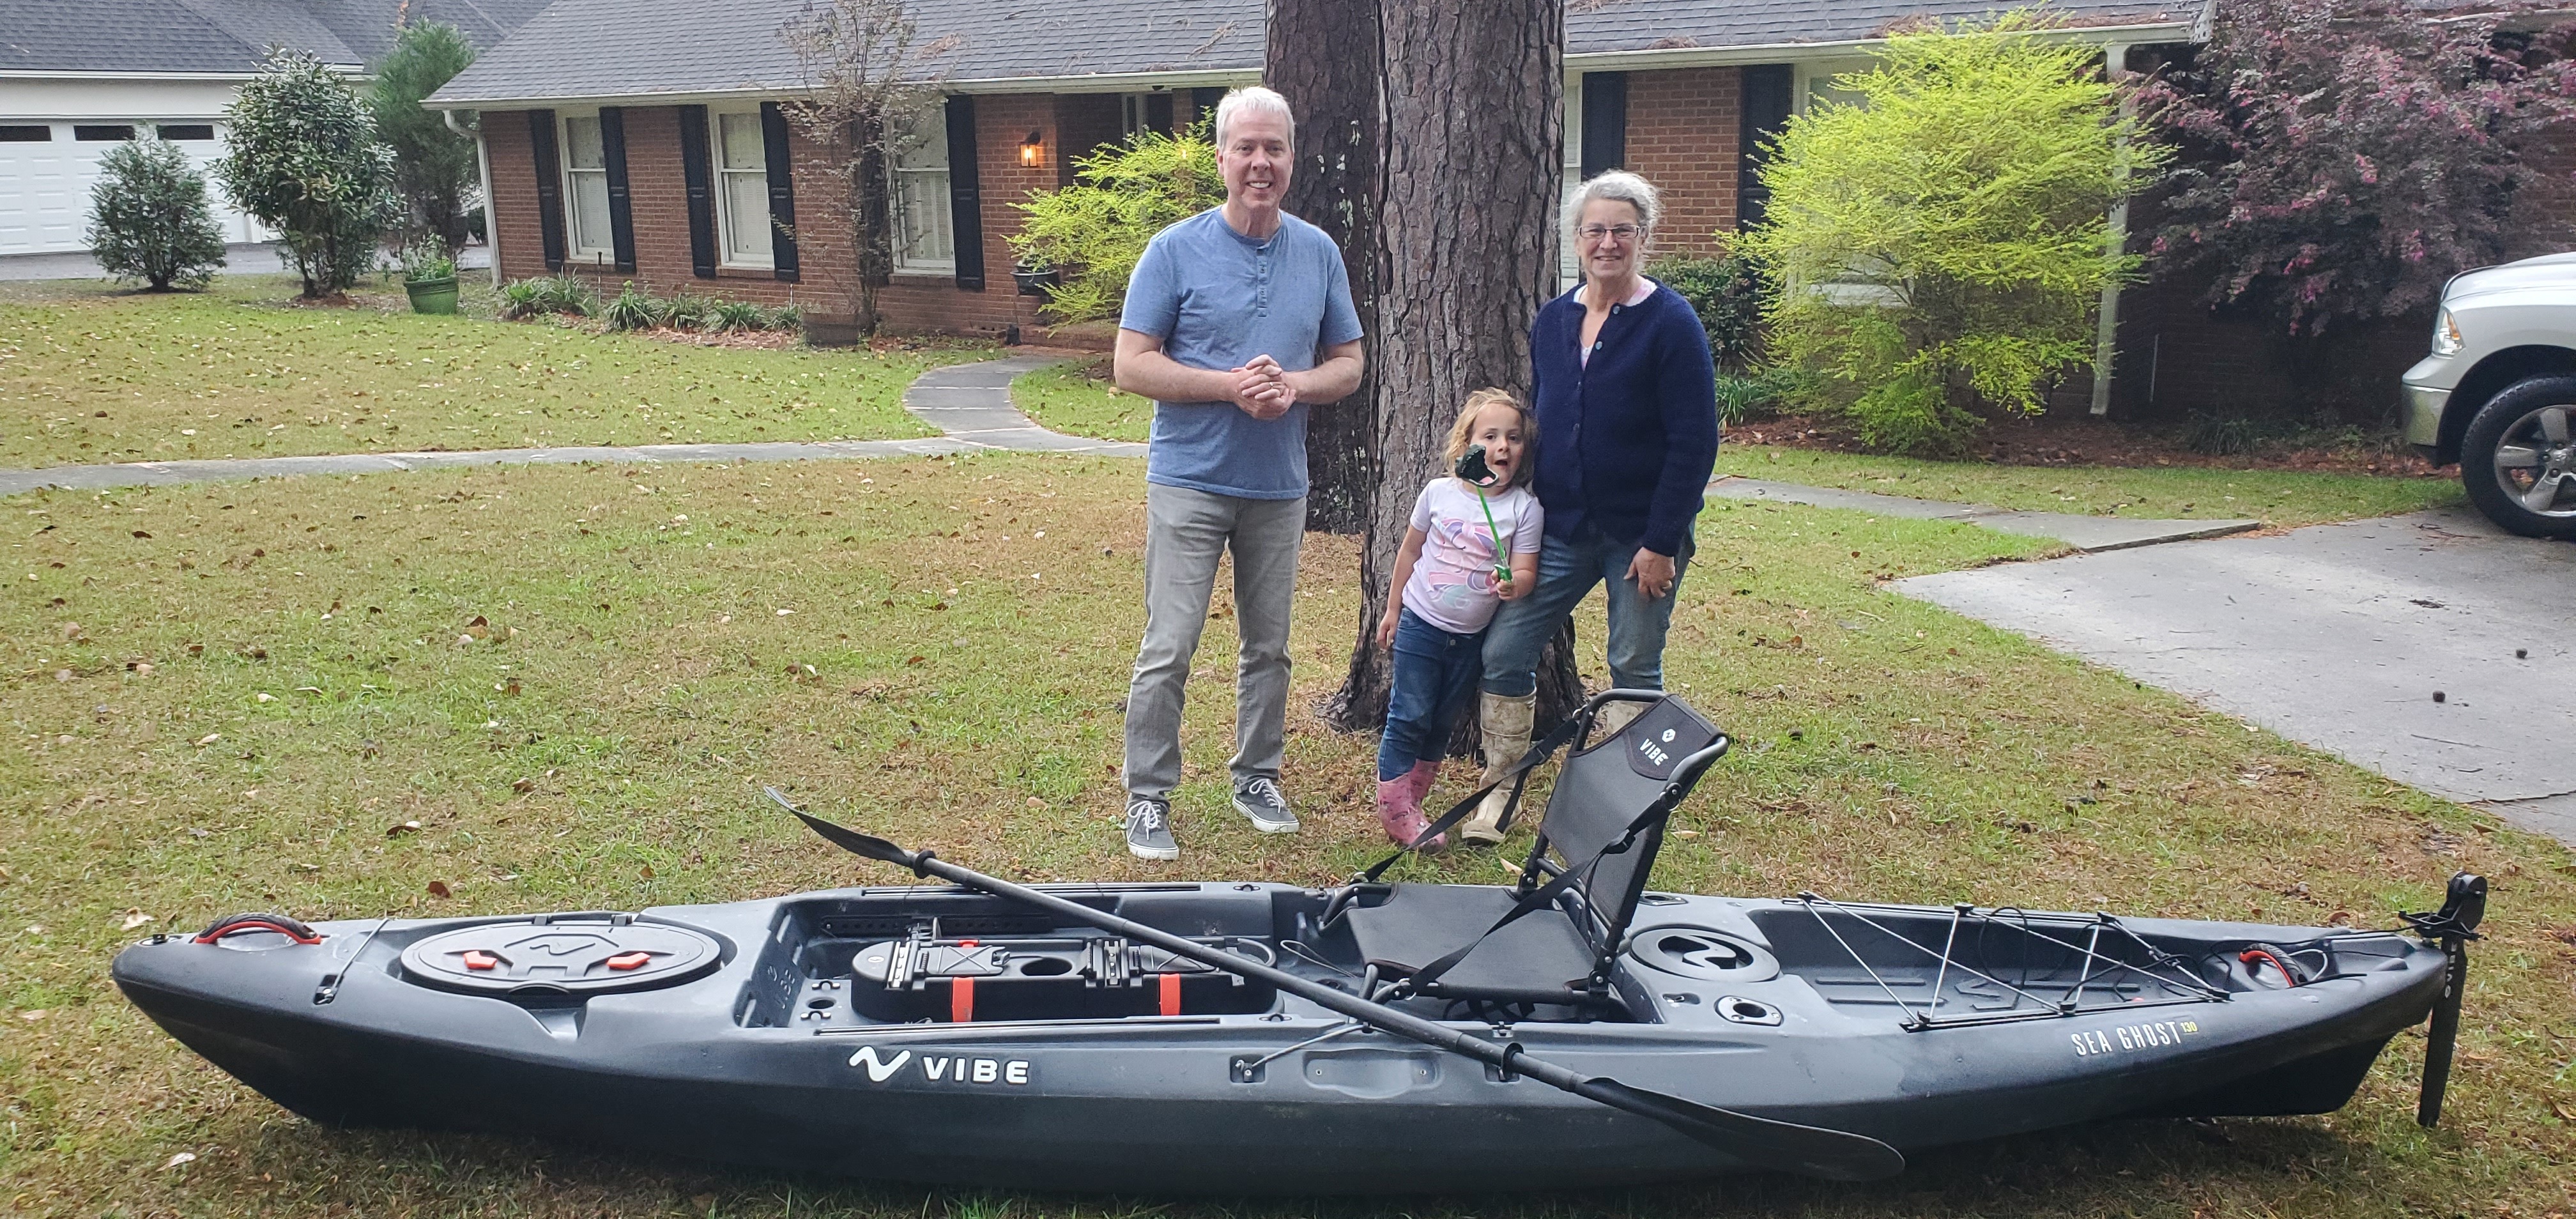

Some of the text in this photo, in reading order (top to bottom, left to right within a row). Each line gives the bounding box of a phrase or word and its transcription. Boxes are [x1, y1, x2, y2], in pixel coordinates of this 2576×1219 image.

[1639, 738, 1669, 766] VIBE
[2071, 1021, 2198, 1055] SEA GHOST 130
[923, 1056, 1030, 1084] VIBE
